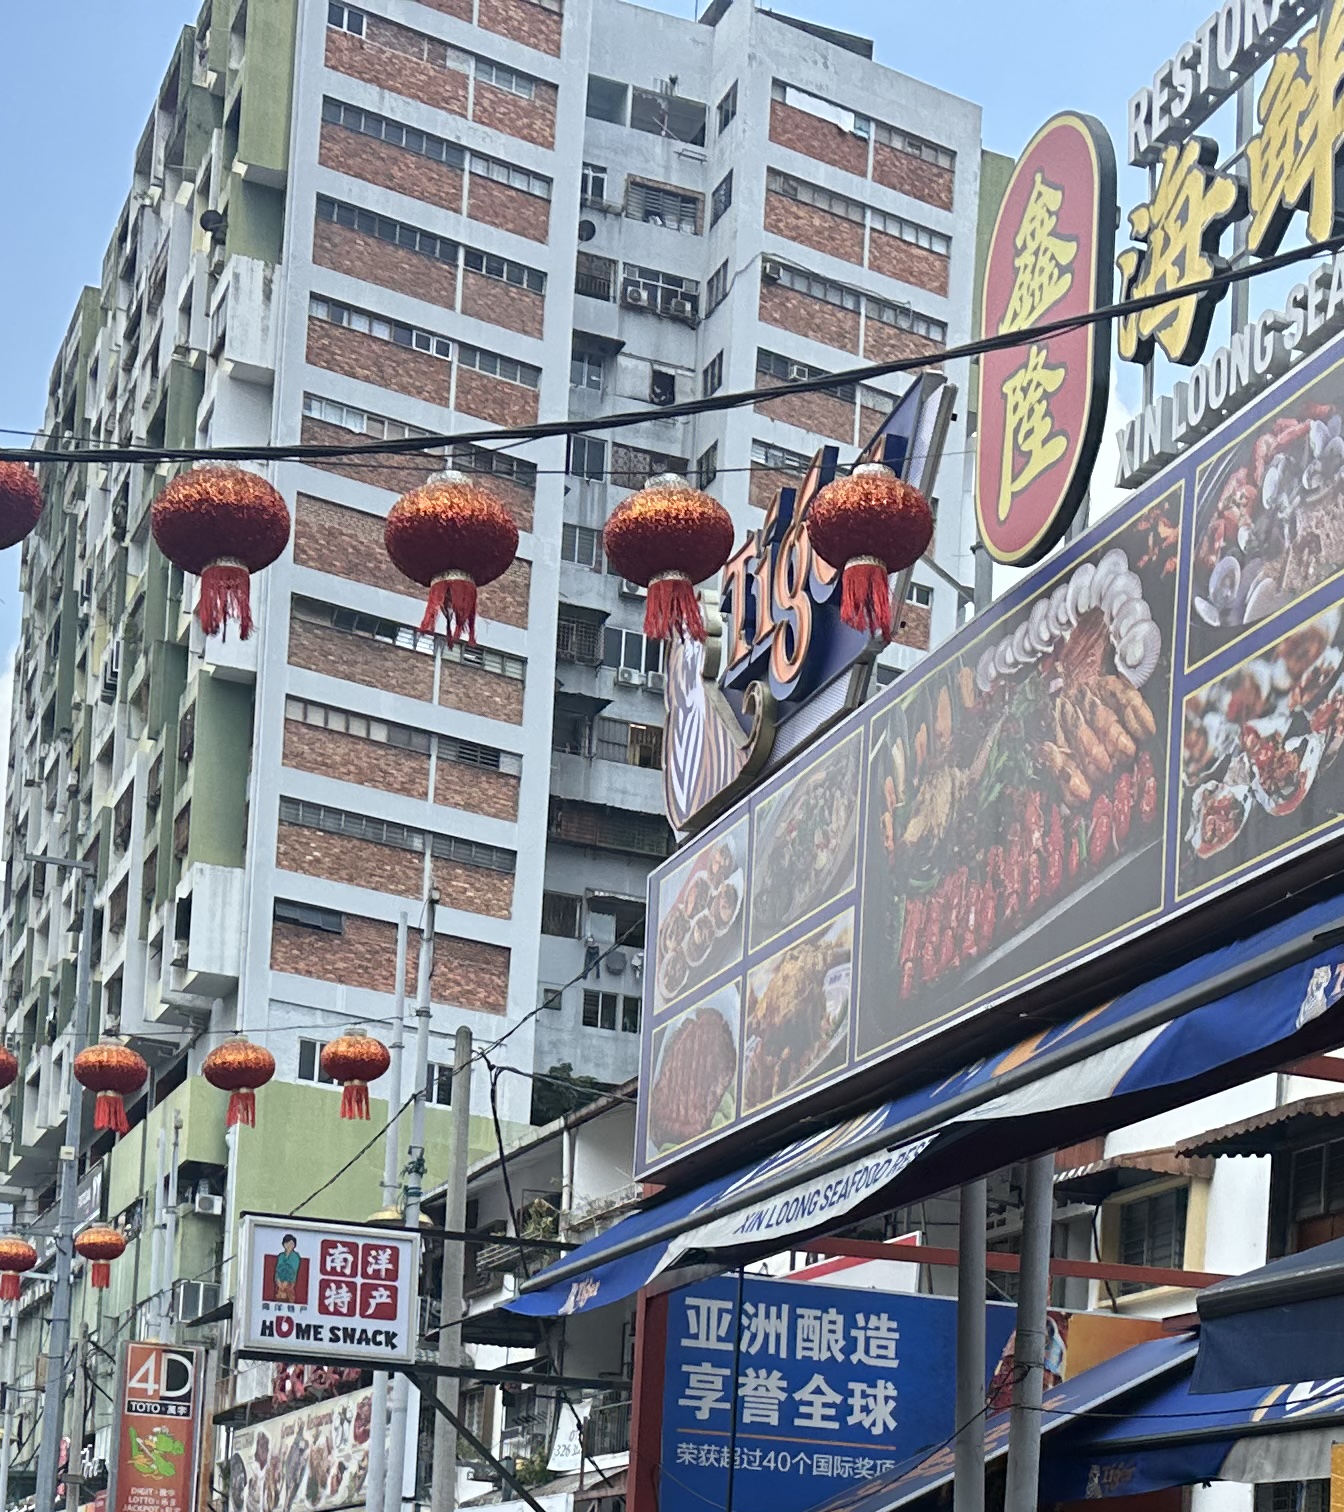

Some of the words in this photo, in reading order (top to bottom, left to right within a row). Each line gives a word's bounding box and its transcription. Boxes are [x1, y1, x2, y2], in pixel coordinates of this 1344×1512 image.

[1128, 0, 1296, 167] RESTORA
[998, 172, 1077, 523] 鑫隆
[1115, 400, 1162, 488] XIN
[1172, 317, 1280, 441] LOONG
[733, 1210, 766, 1235] XIN
[765, 1188, 822, 1230] LOONG
[819, 1157, 893, 1212] SEAFOOD
[325, 1242, 394, 1279] 南洋
[324, 1281, 393, 1317] 特产
[260, 1315, 325, 1343] HOME
[328, 1325, 399, 1351] SNACK
[680, 1296, 900, 1369] 亚洲酿造
[128, 1350, 194, 1399] 4D
[678, 1362, 898, 1436] 享誉全球
[130, 1401, 161, 1414] TOTO
[128, 1496, 155, 1505] LOTTO
